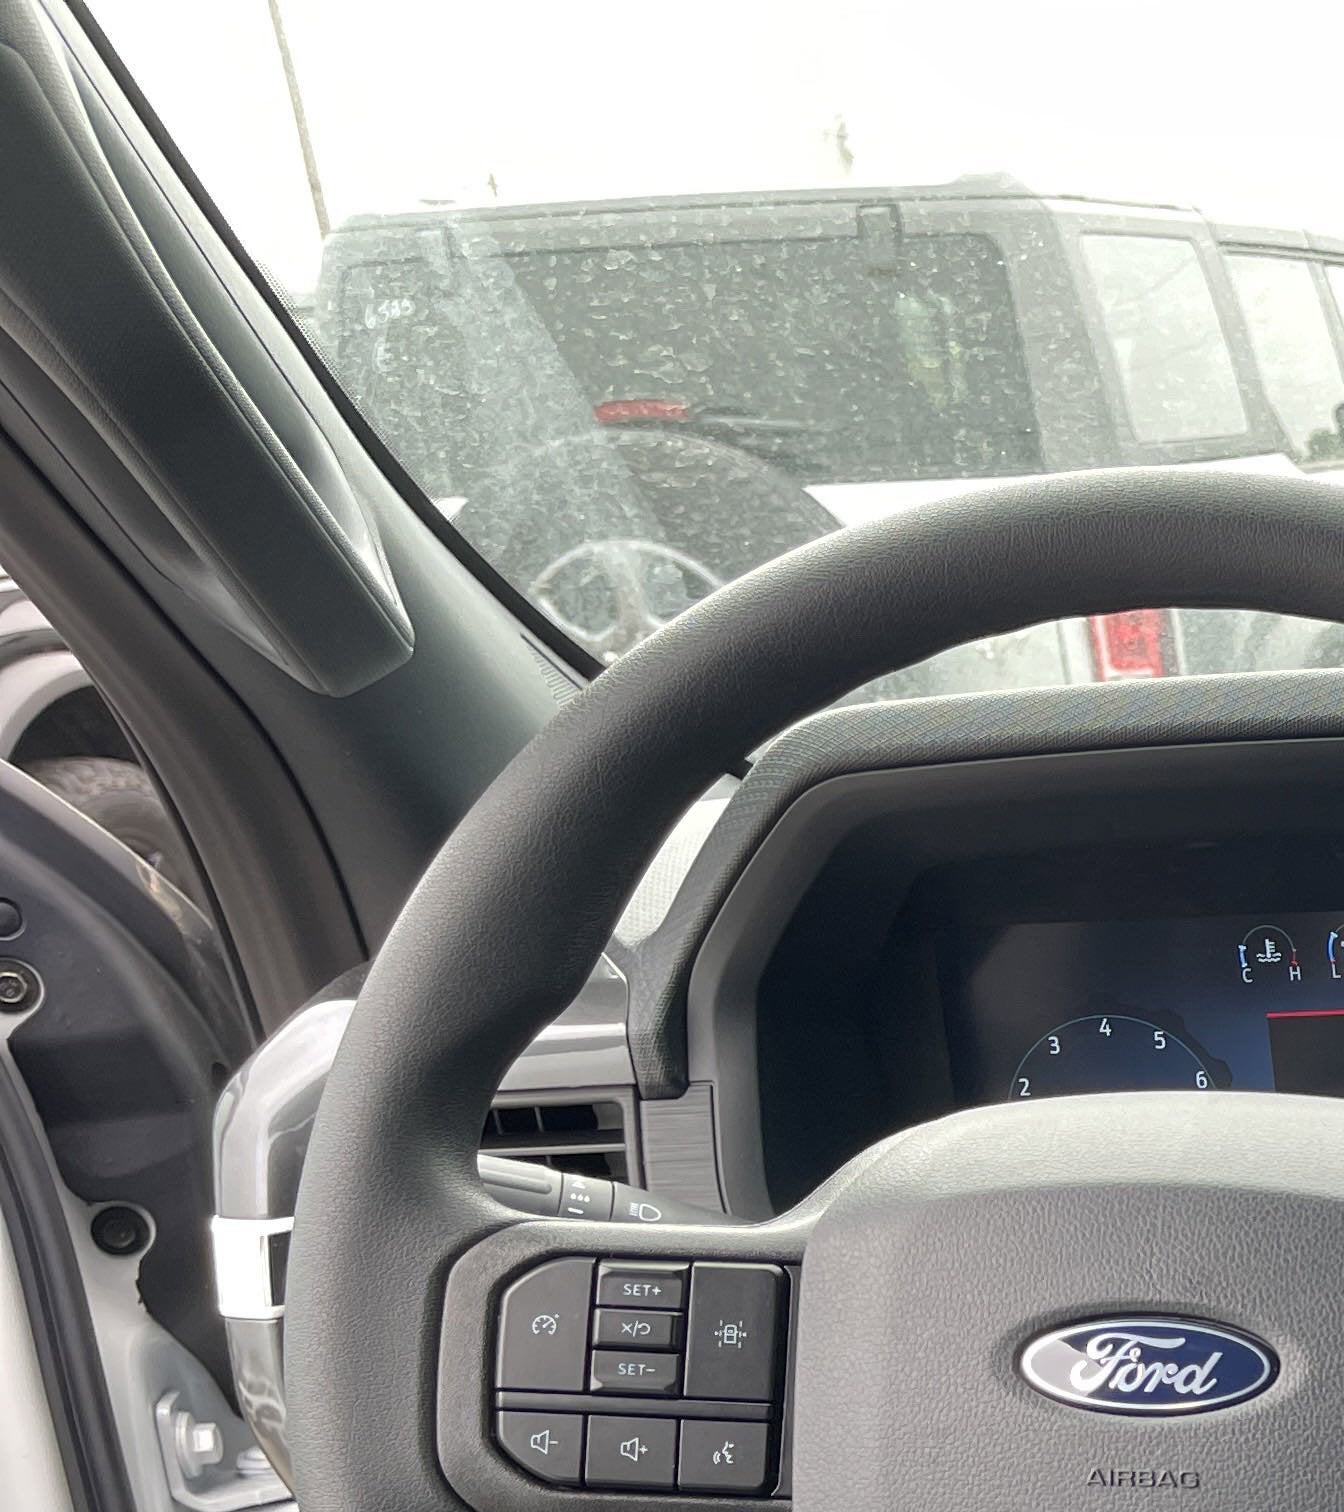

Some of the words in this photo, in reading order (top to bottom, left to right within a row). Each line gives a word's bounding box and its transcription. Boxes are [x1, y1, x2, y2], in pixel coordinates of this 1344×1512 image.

[1099, 1018, 1112, 1037] 4
[1048, 1036, 1061, 1055] 3
[1154, 1031, 1167, 1050] 5
[1018, 1077, 1031, 1096] 2
[1195, 1070, 1208, 1089] 6
[1070, 1332, 1224, 1395] Ford
[1087, 1468, 1201, 1490] AIRBAG
